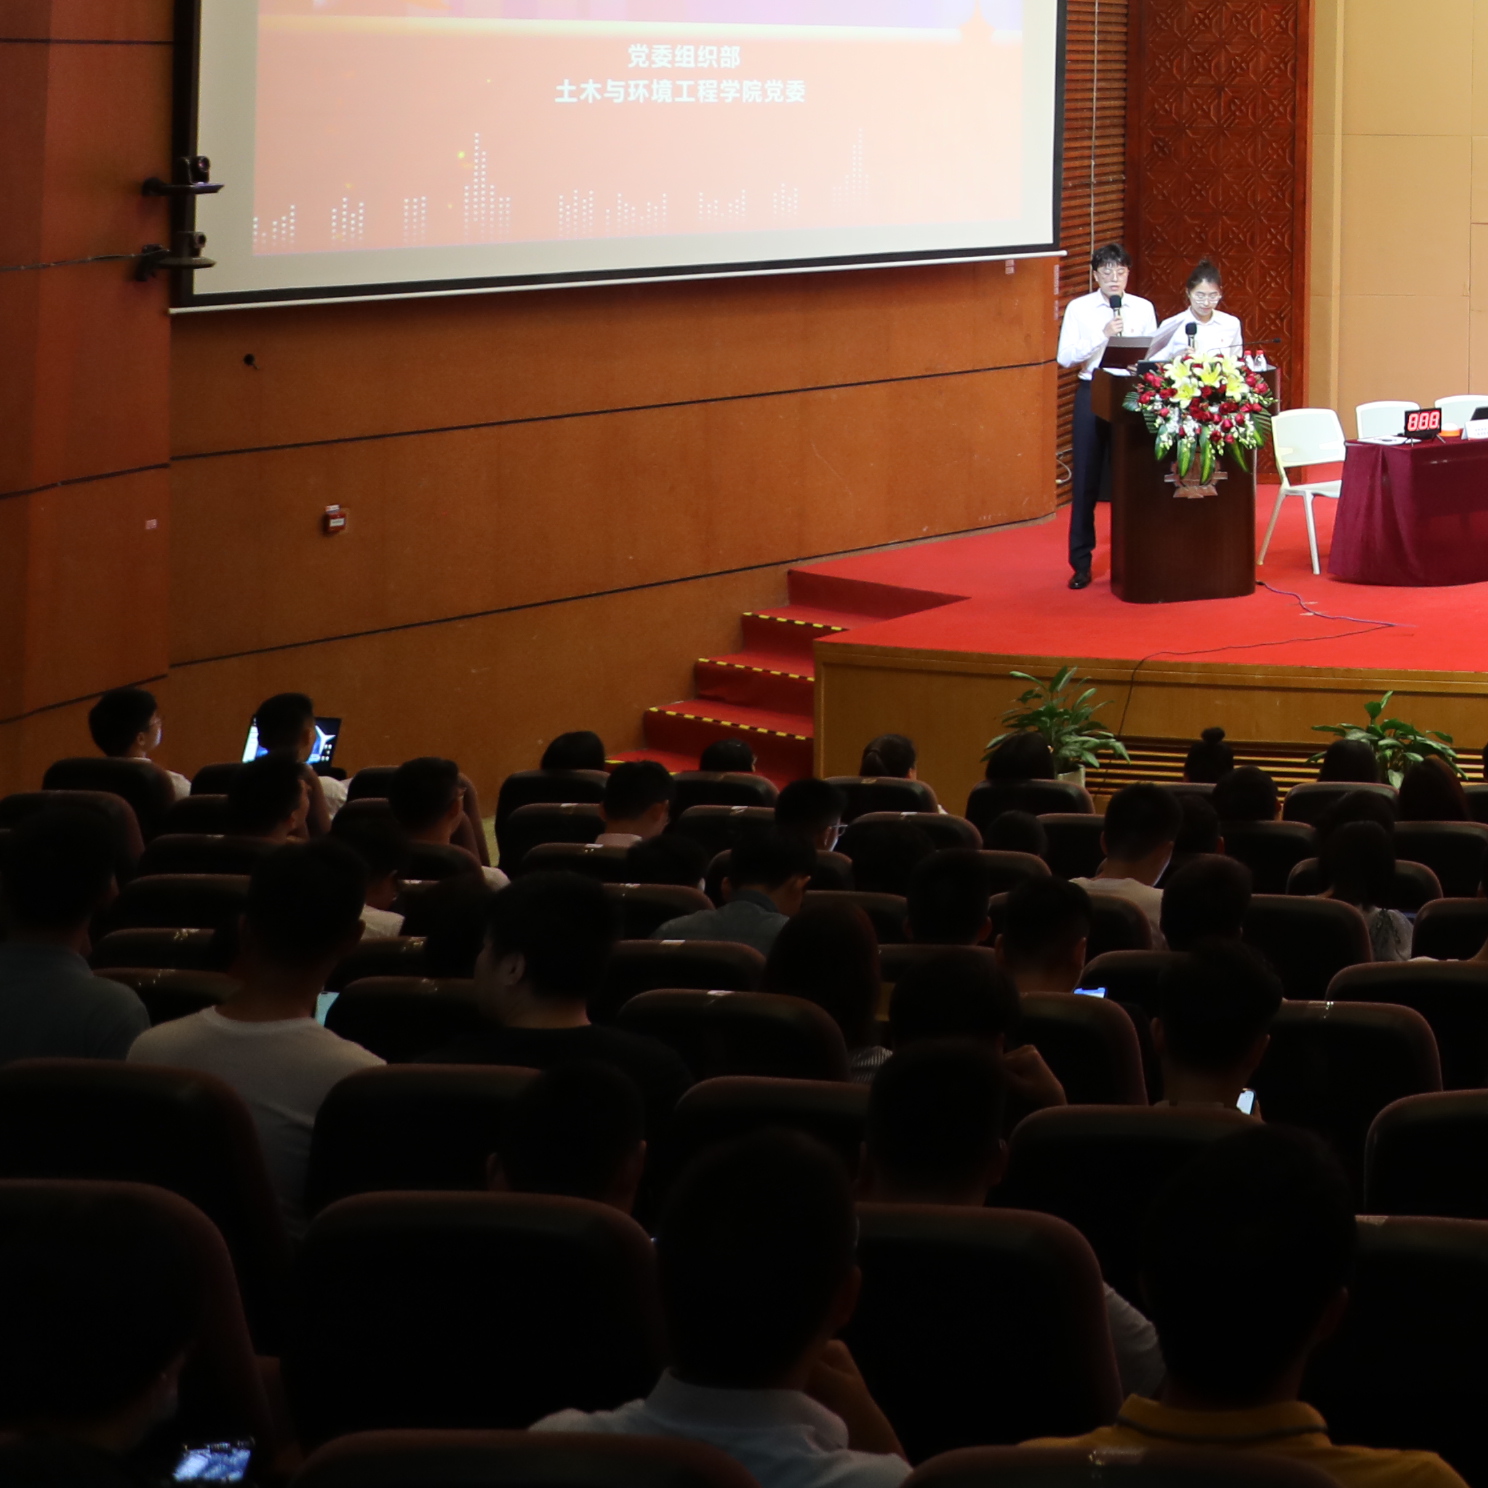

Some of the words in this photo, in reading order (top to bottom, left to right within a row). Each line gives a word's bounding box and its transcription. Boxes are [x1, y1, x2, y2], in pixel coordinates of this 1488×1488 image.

[628, 44, 741, 69] 党委组织部
[554, 79, 806, 103] 土木与环境工程学院党委
